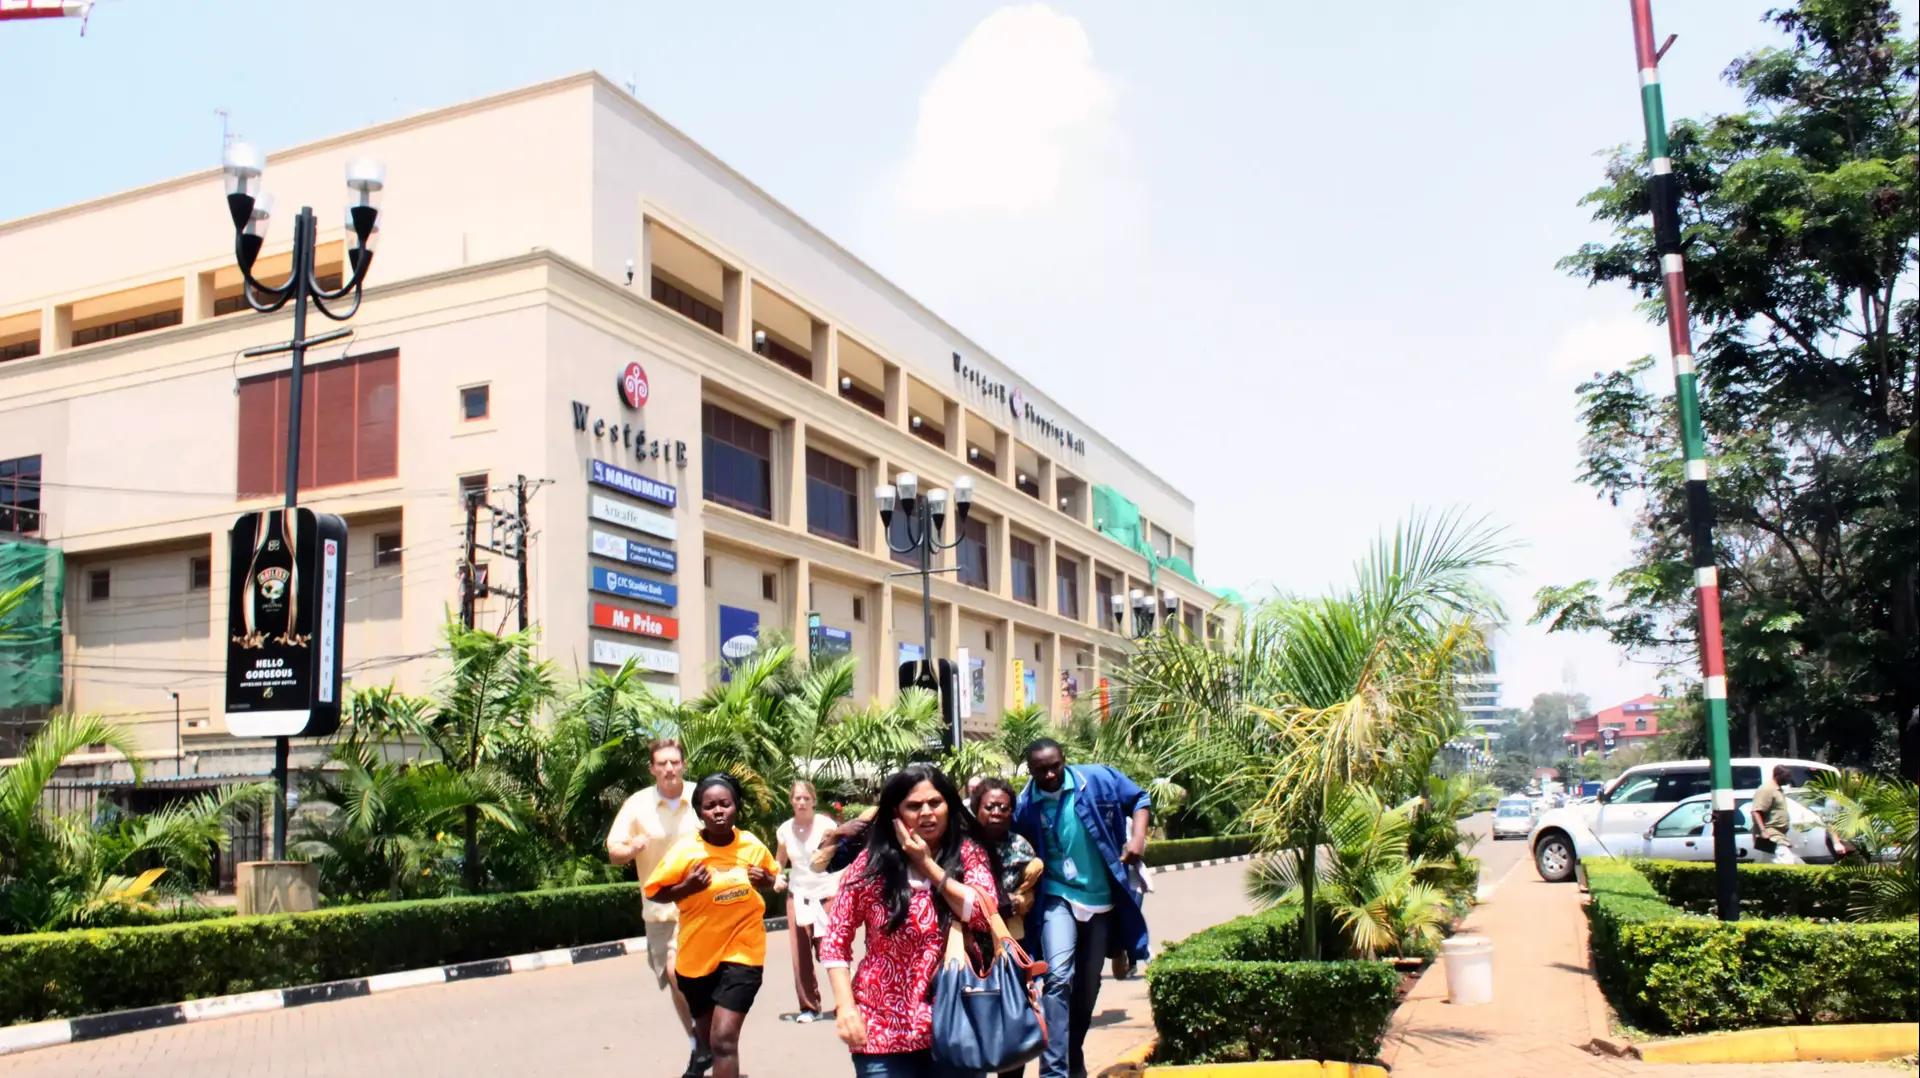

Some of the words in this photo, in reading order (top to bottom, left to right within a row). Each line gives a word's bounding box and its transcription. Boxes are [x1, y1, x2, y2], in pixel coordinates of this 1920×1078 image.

[1024, 402, 1064, 447] Shopping
[1066, 430, 1085, 456] Mall
[605, 467, 675, 503] NAKUMATT
[617, 576, 628, 588] CFC
[628, 579, 648, 592] Stanbic
[648, 584, 662, 595] Bank
[612, 609, 630, 628] Mr
[633, 613, 663, 635] Price
[245, 668, 293, 680] GORGEOUS
[256, 658, 284, 668] HELLO
